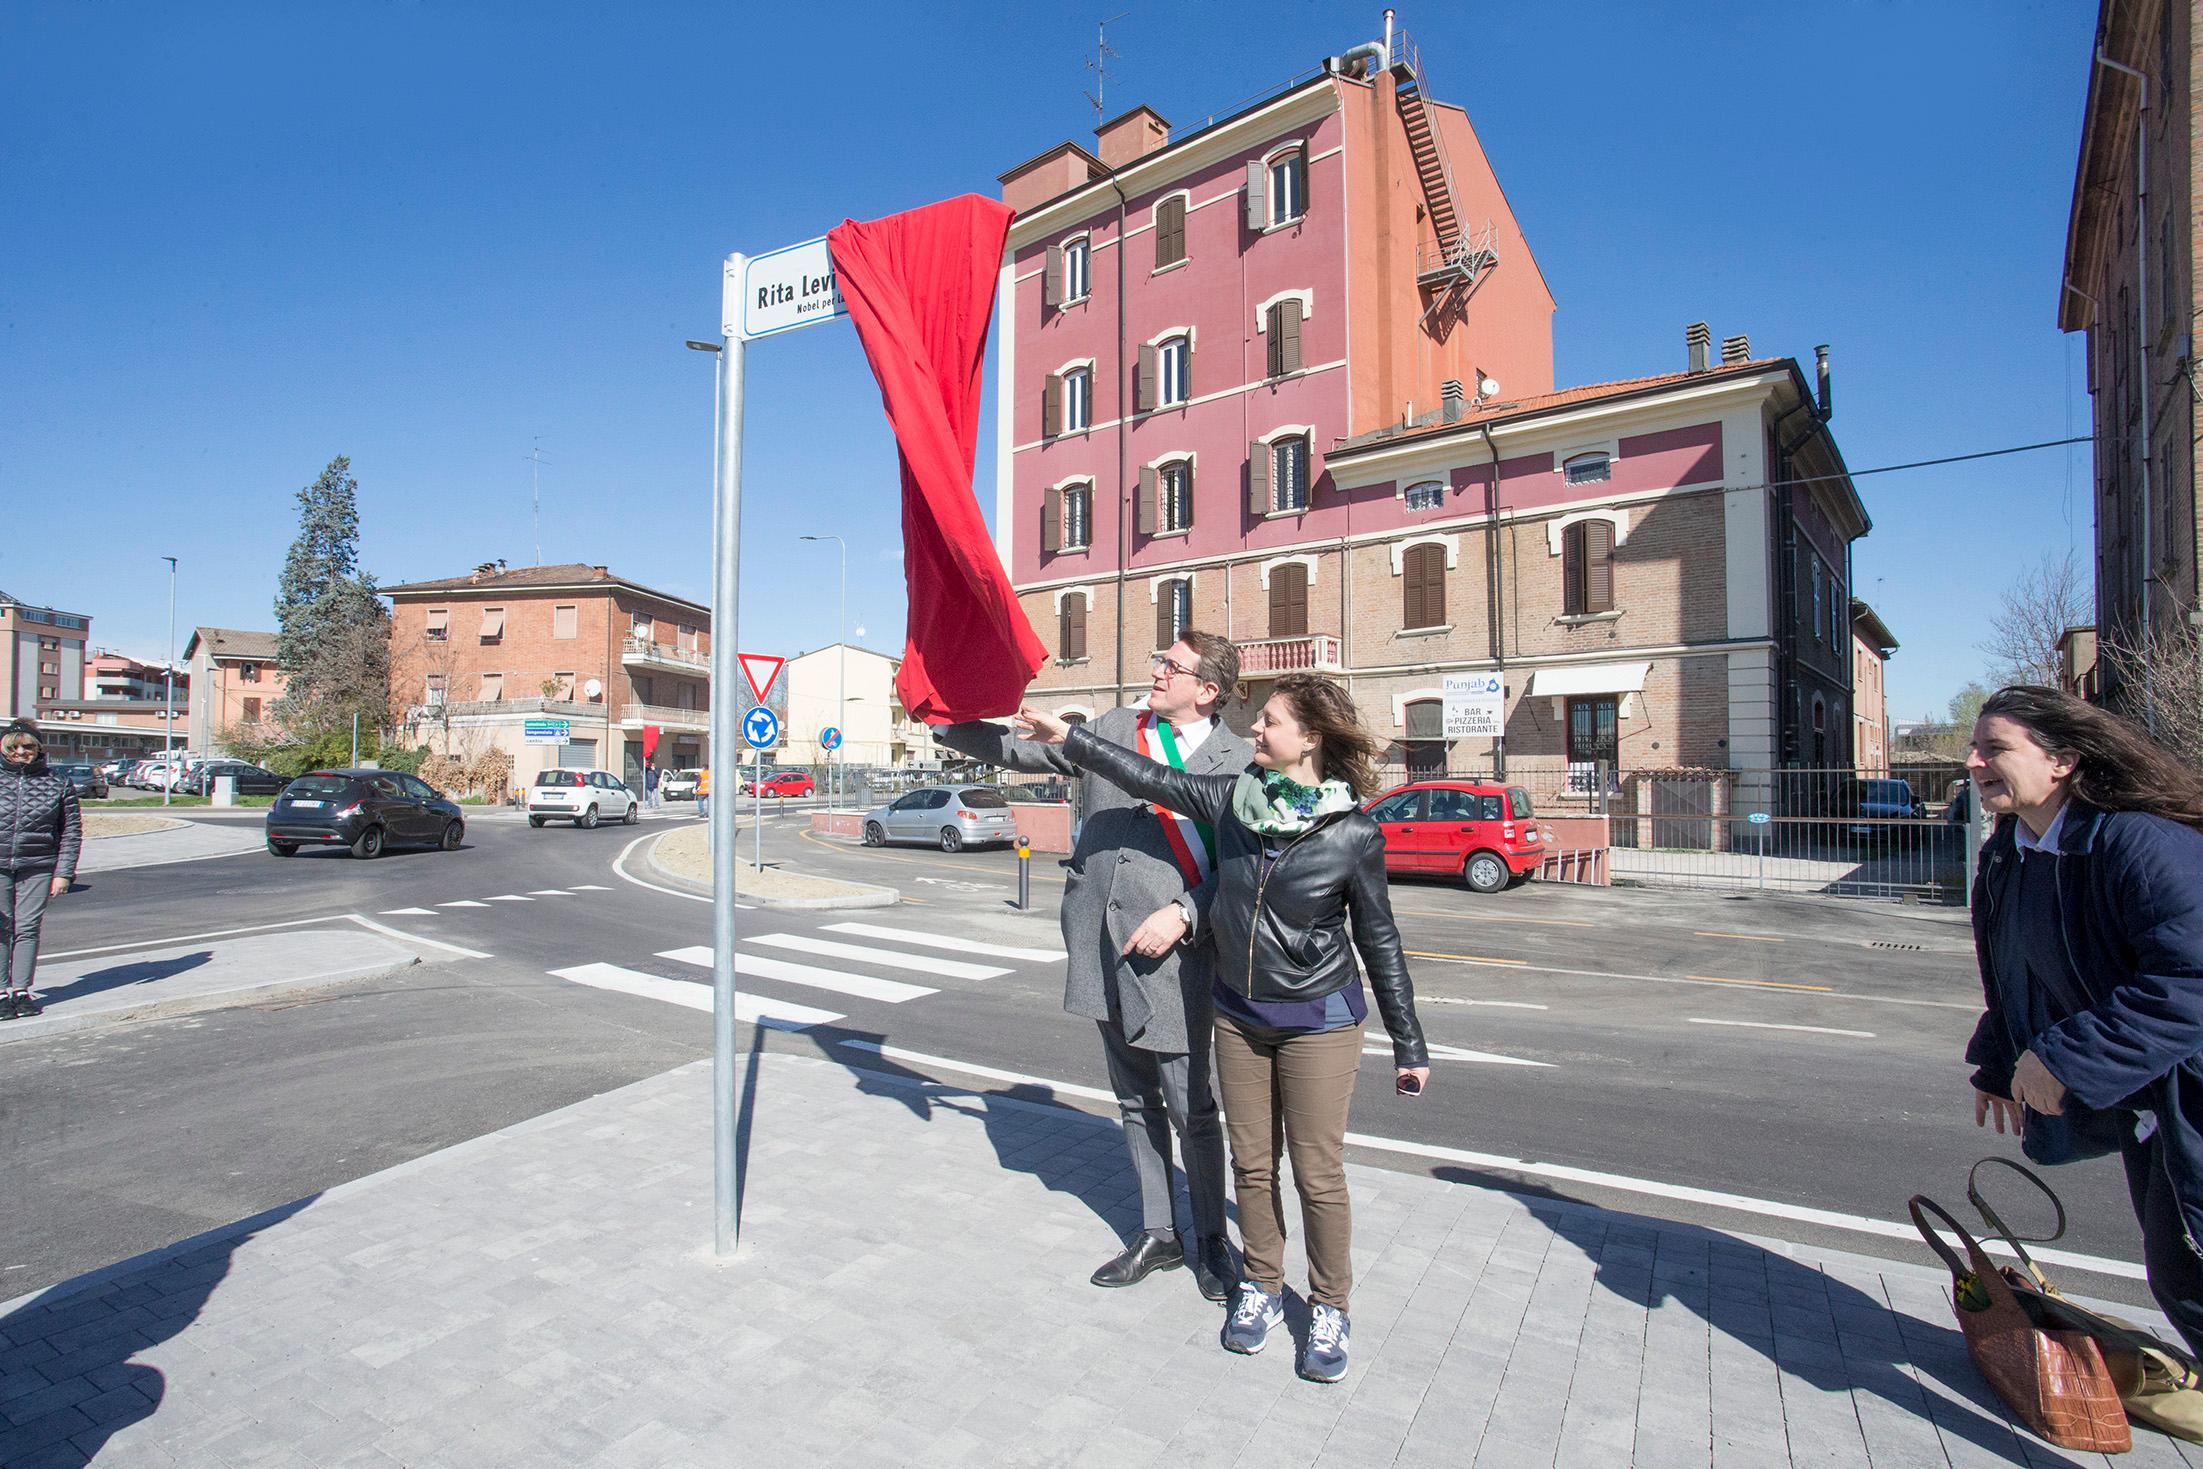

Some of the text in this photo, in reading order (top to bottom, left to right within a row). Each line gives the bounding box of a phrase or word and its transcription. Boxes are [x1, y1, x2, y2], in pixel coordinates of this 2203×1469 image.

[758, 267, 836, 309] Rita Levi
[797, 299, 820, 314] Nobel
[822, 298, 835, 309] per
[1446, 678, 1485, 691] Punjab
[1464, 708, 1482, 716] BAR
[1454, 716, 1491, 725] PIZZERIA
[1447, 725, 1498, 734] RISTORANTE
